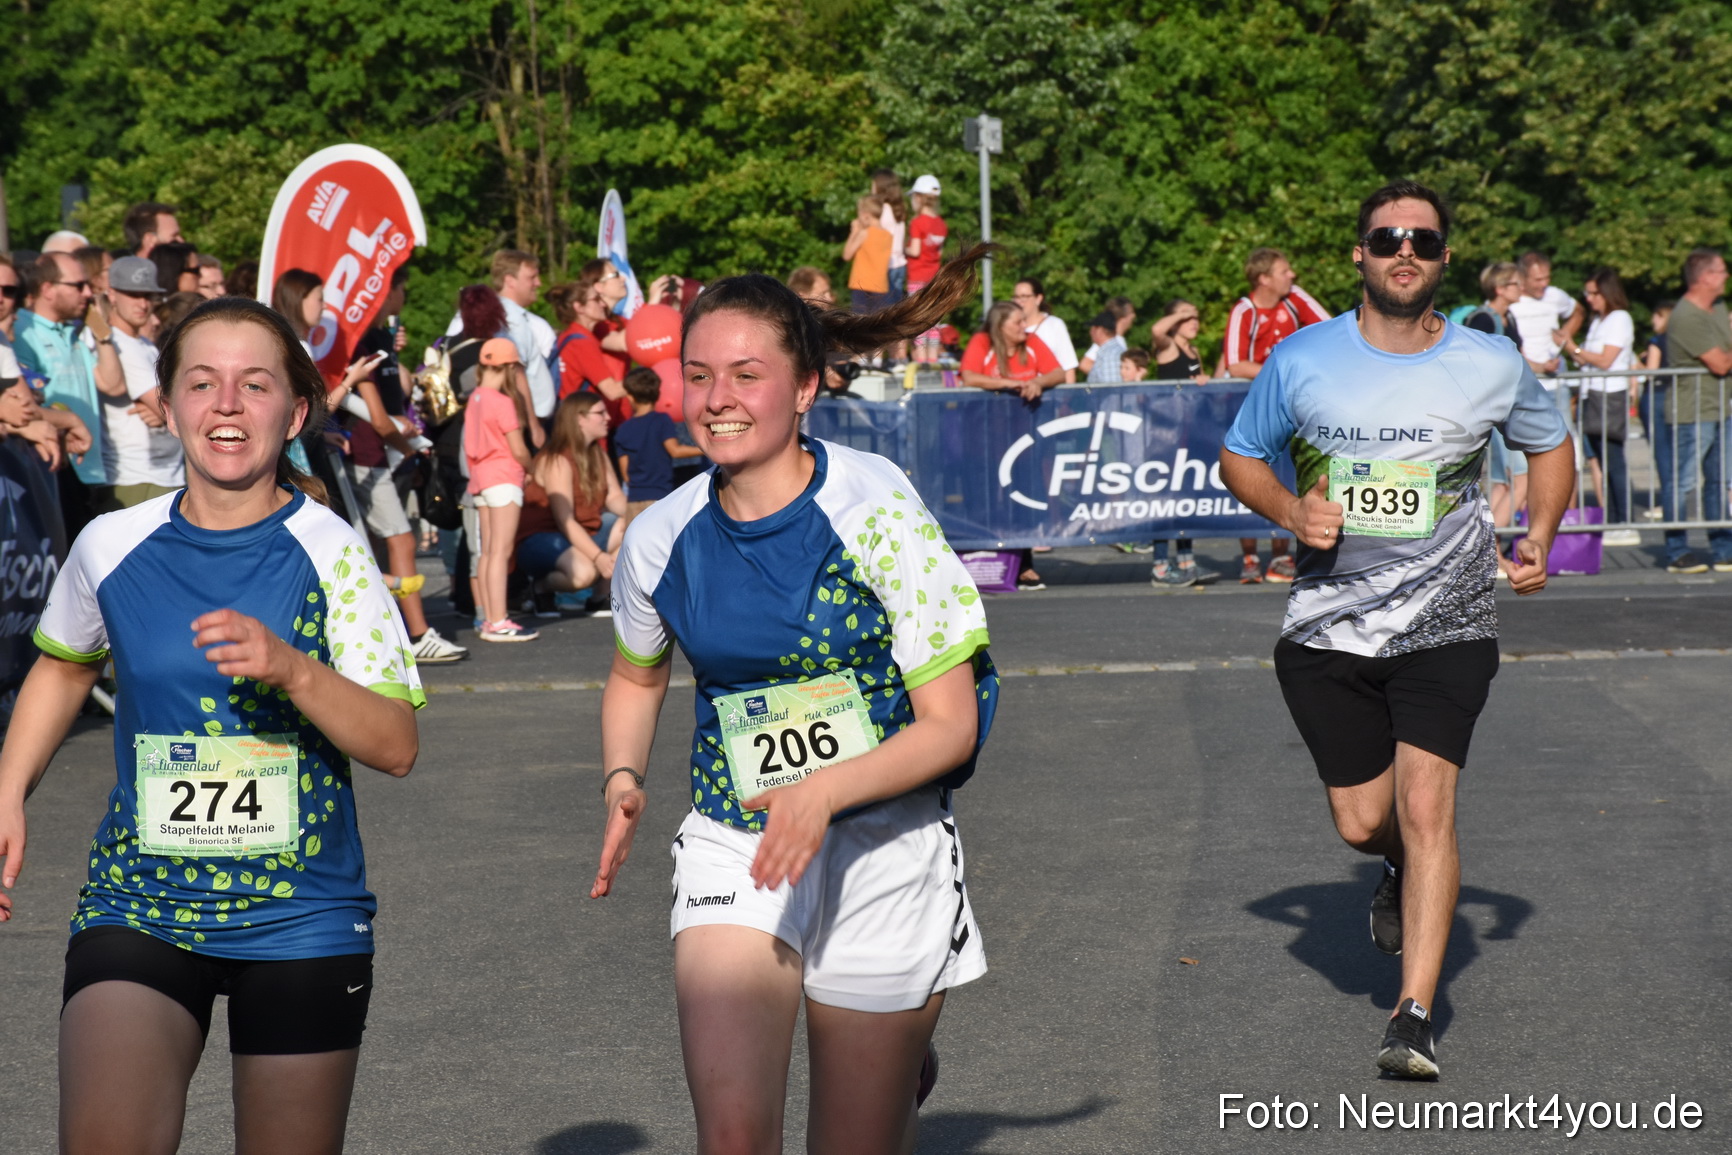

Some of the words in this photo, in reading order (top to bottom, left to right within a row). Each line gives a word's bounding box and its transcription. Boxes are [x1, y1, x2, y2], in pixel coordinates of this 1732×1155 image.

[306, 180, 337, 225] AVIA
[345, 231, 408, 324] energie
[1047, 448, 1228, 496] Fisch
[1344, 472, 1386, 482] firmenlauf
[1342, 486, 1420, 516] 1939
[1346, 513, 1383, 523] Kitsoukis
[1384, 516, 1414, 524] Ioannis
[739, 707, 789, 728] firmenlauf
[826, 700, 853, 717] 2019
[753, 721, 839, 775] 206
[159, 759, 221, 772] firmenlauf
[259, 765, 288, 777] 2019
[756, 770, 803, 788] Federsel
[169, 779, 262, 822] 274
[160, 823, 224, 837] Stapelfeldt
[228, 823, 275, 835] Melanie
[188, 837, 229, 845] Bionorica
[231, 837, 243, 845] SE
[686, 891, 736, 909] hummel
